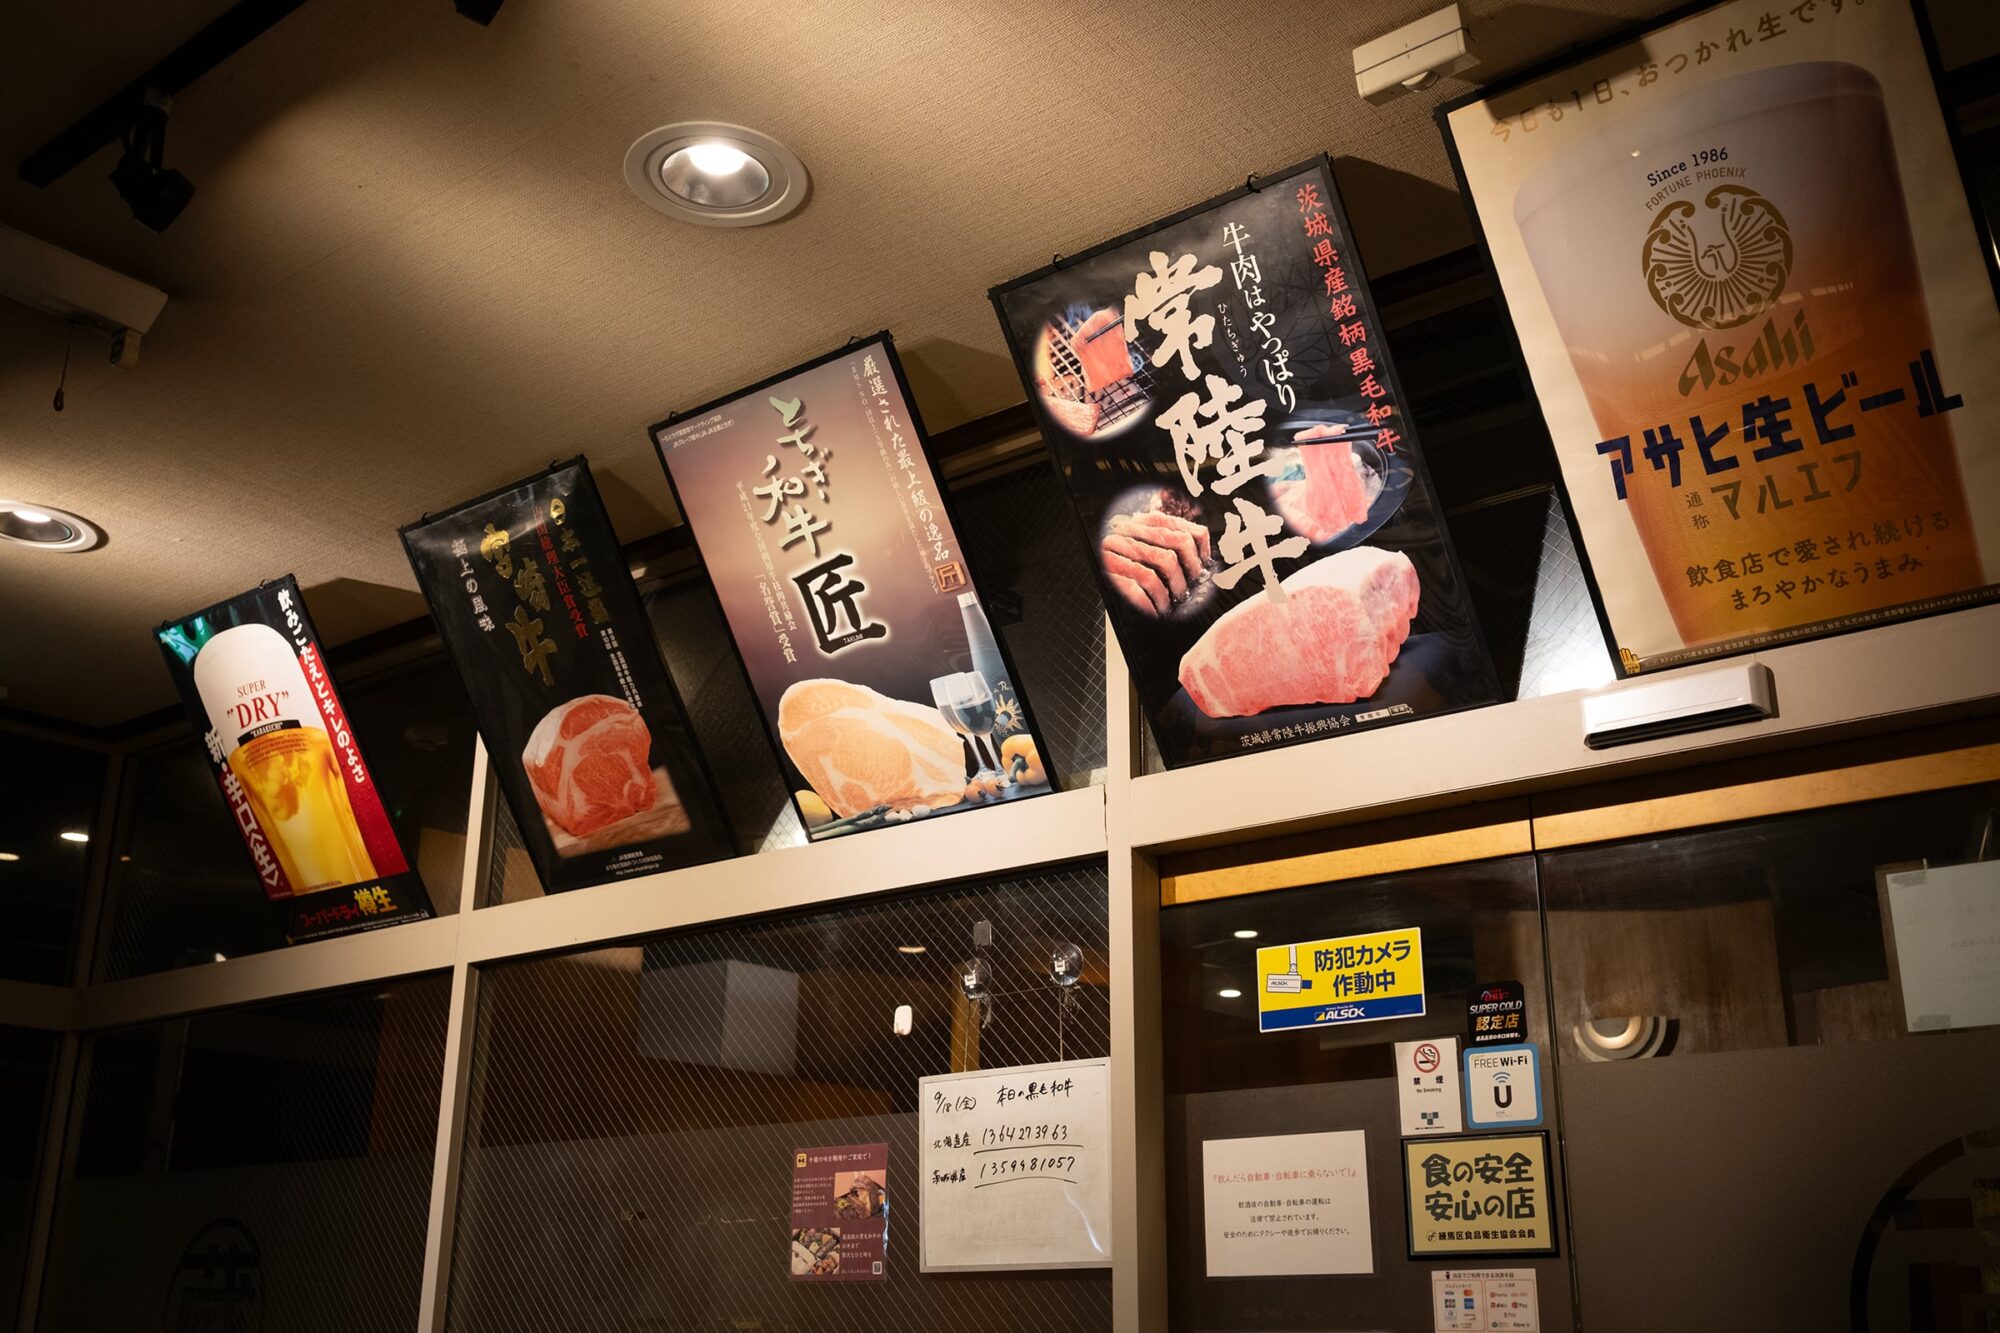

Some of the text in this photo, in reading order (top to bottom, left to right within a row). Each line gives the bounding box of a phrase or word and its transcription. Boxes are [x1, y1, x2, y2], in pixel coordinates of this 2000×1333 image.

[1647, 147, 1729, 187] Since 1986
[1645, 167, 1748, 211] FORTUNE PHOENIX
[1222, 222, 1297, 414] 牛肉はやっぱり
[1296, 183, 1401, 454] 茨城県産銘柄黒毛和牛
[1217, 303, 1248, 378] ひたちぎゅう
[1677, 309, 1816, 397] Asahi
[1122, 251, 1311, 600] 常陸牛
[1595, 349, 1964, 500] アサヒ生ビール
[1710, 451, 1864, 521] マルエフ
[1685, 491, 1710, 530] 通称
[1685, 510, 1950, 588] 飲食店で愛され続ける
[1731, 552, 1923, 611] まろやかなうまみ
[792, 553, 887, 654] 匠
[237, 680, 267, 698] SUPER
[278, 588, 366, 784] 飲みごたえとキレのよさ
[1239, 714, 1351, 748] 茨城県常陸牛振興協会
[1314, 939, 1411, 973] 防犯カメラ
[1333, 969, 1396, 998] 作動中
[1325, 1007, 1366, 1020] ALSOK
[1469, 1000, 1523, 1014] SUPER COLD
[1476, 1013, 1520, 1031] 認定店
[1474, 1055, 1528, 1069] FREE Wi-Fi
[996, 1077, 1074, 1107] 本日の黒毛和牛
[933, 1124, 1068, 1149] 北海道産 1364273963
[1421, 1152, 1534, 1188] 食の安全
[1250, 1213, 1320, 1223] 法律で禁止されています。
[1425, 1187, 1535, 1221] 安心の店
[1438, 1229, 1535, 1240] 練馬区食品衛生協会会員
